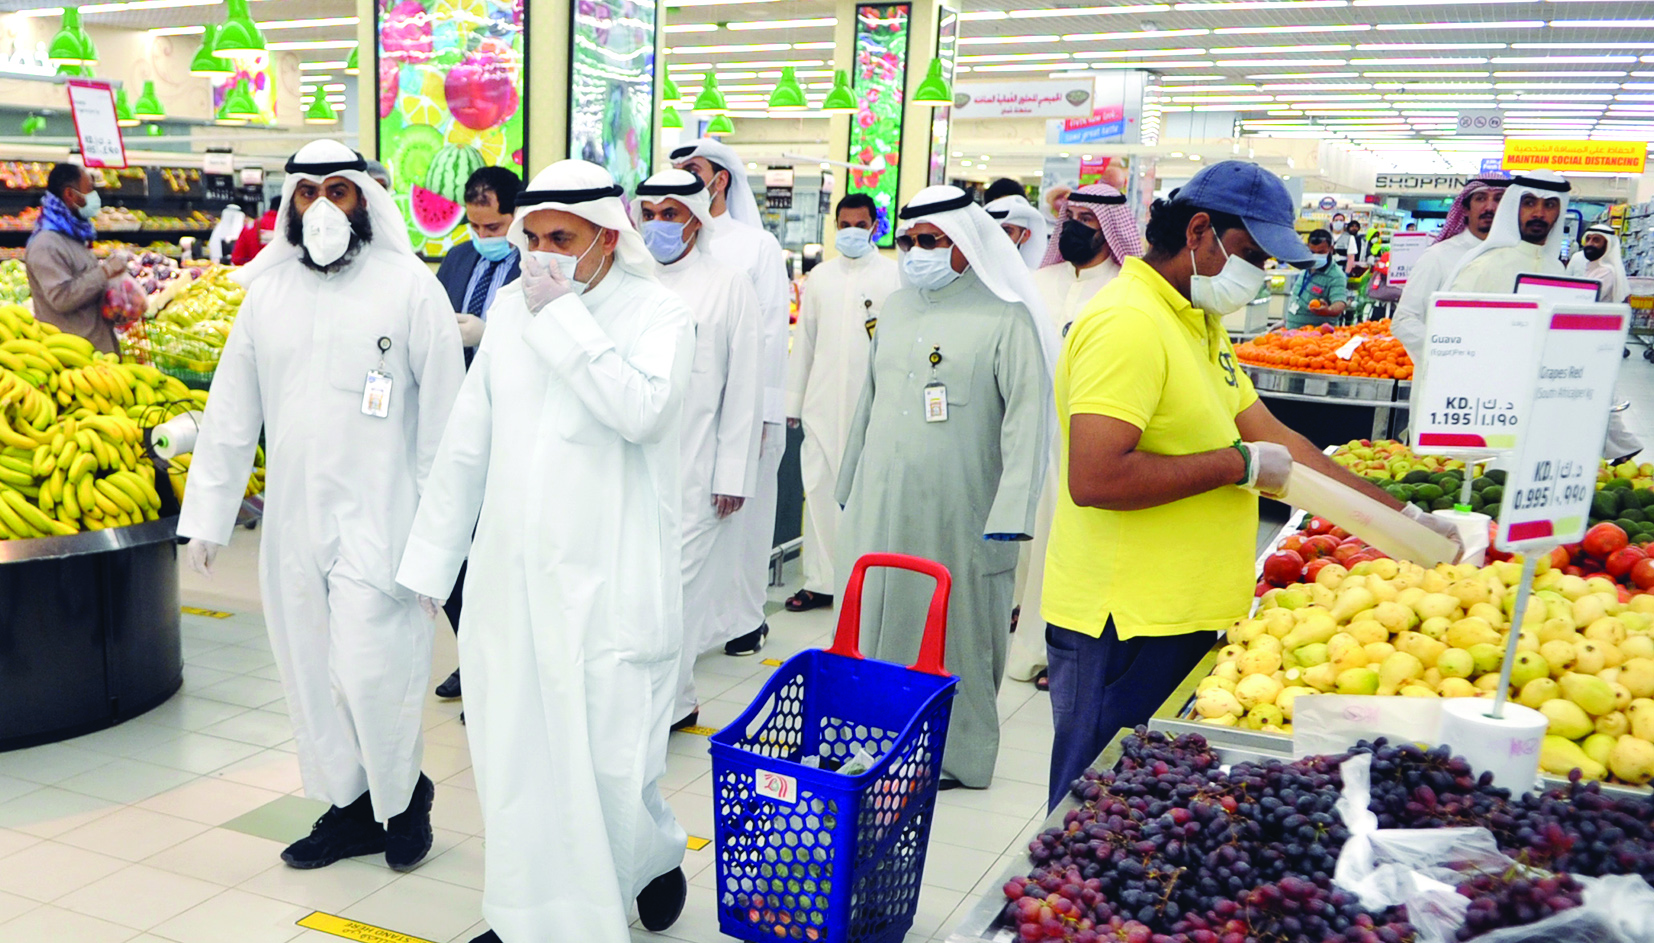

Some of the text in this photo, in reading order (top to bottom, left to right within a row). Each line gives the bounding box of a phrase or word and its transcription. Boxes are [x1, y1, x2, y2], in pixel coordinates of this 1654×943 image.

[1513, 144, 1635, 155] الحفاظ على المسافة الشخصية
[1507, 154, 1550, 164] MAINTAIN
[1551, 155, 1583, 165] SOCIAL
[1584, 156, 1640, 166] DISTANCING
[1431, 334, 1463, 344] Guava
[1540, 365, 1585, 381] Grapes Red
[1446, 396, 1473, 410] KD.
[1430, 412, 1472, 425] 1.195
[1481, 413, 1518, 426] ١.١٩٥
[1533, 460, 1553, 482] KD.
[1514, 486, 1550, 510] 0.995
[344, 921, 374, 934] HERE
[375, 929, 411, 943] STAND
